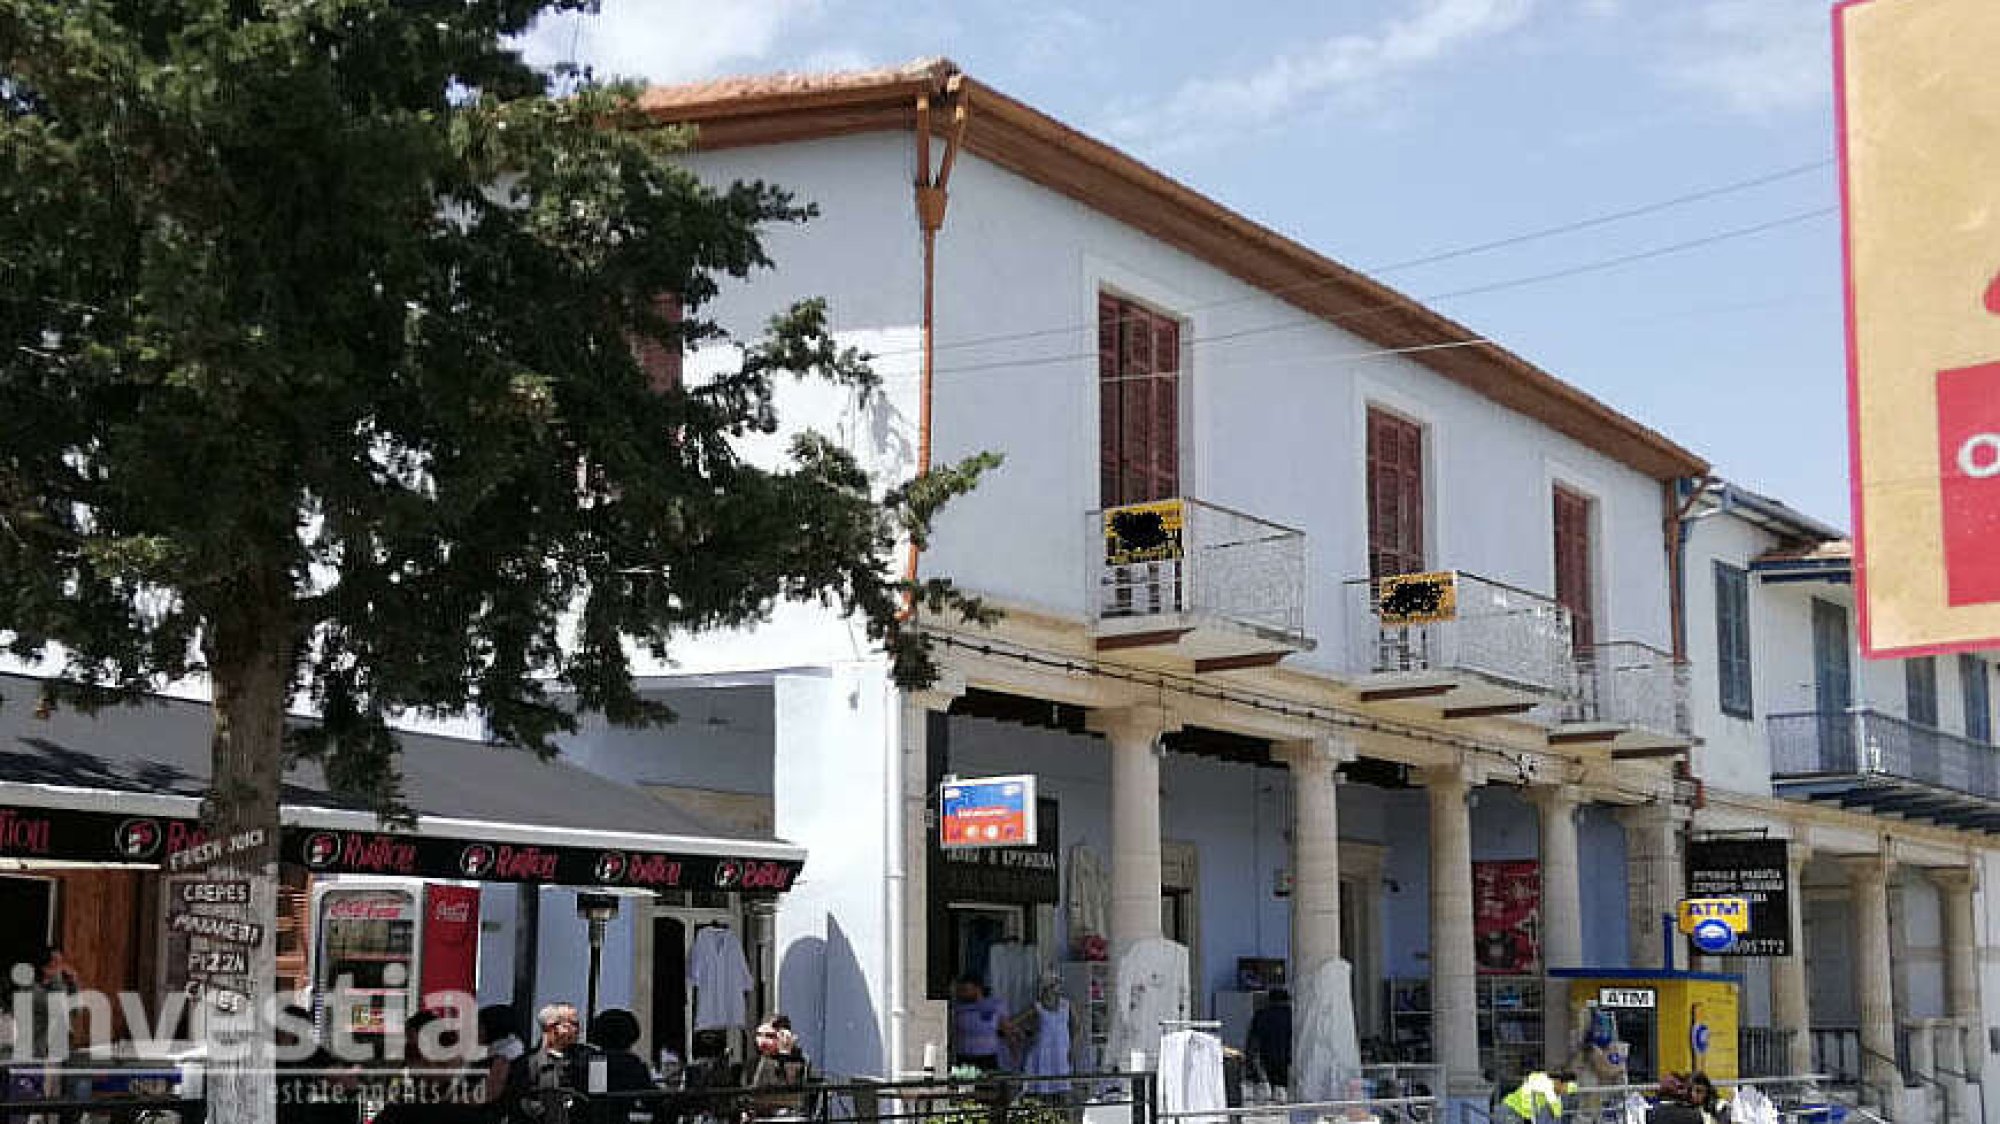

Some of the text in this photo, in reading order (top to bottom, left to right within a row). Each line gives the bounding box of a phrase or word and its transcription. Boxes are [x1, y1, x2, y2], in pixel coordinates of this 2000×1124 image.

[1689, 902, 1739, 916] ATM
[188, 952, 245, 972] PIZZA
[1607, 991, 1650, 1004] ATM
